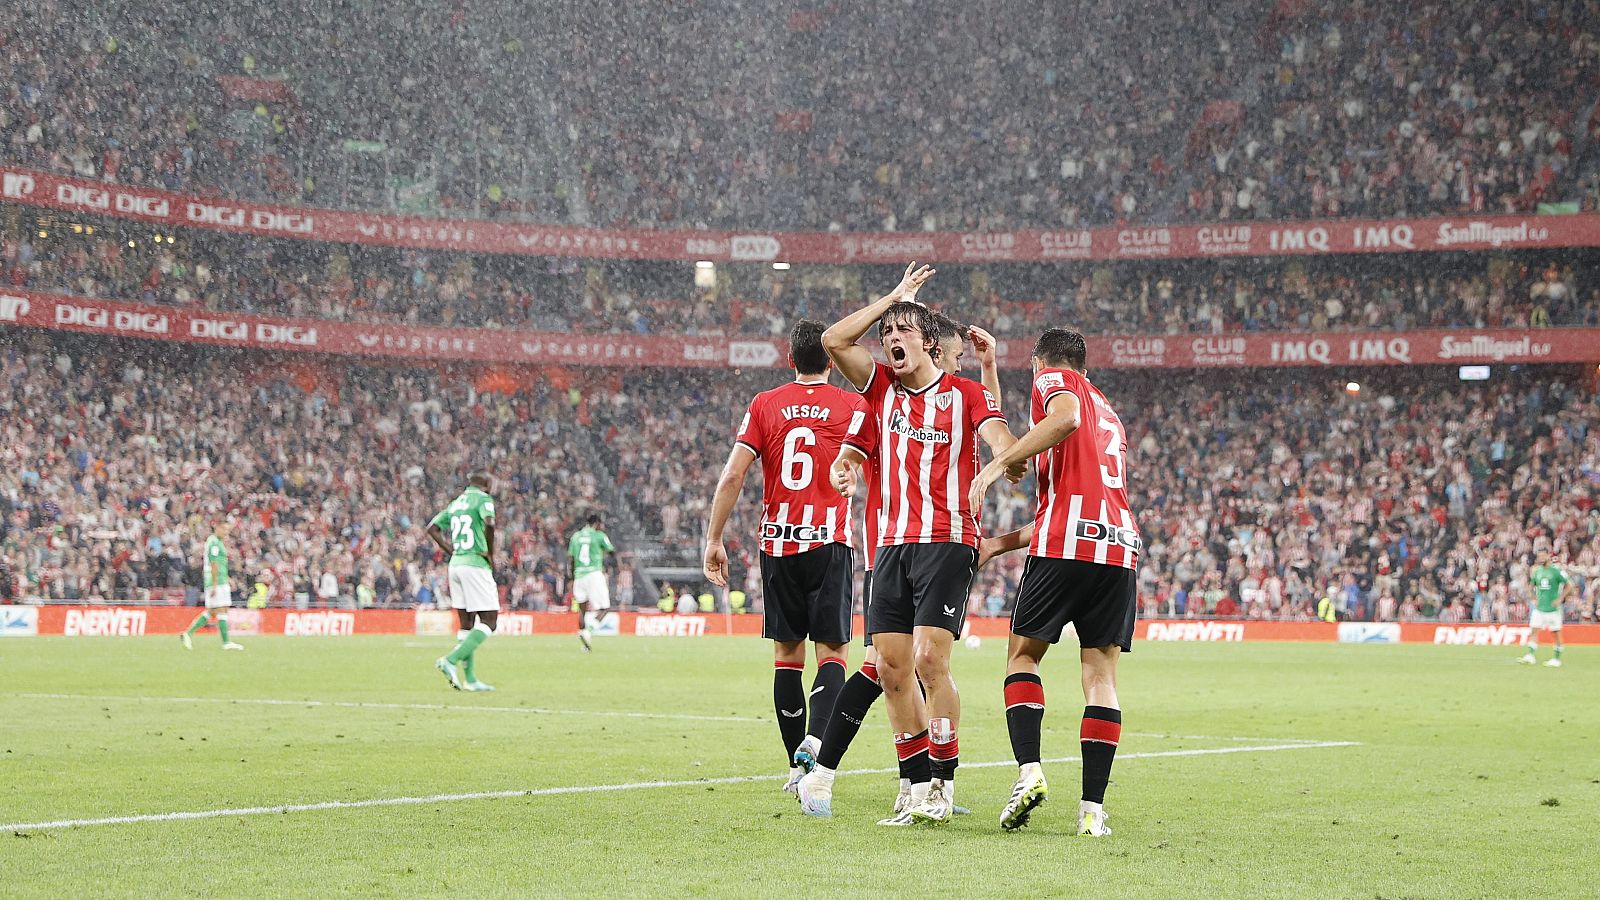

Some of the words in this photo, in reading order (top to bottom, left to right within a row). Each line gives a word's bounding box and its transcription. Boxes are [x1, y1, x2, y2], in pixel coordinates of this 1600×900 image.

[57, 184, 110, 209] DIGI
[115, 193, 170, 217] DIGI
[187, 202, 245, 227] DIGI
[251, 211, 314, 233] DIGI
[961, 233, 1015, 249] CLUB
[1040, 231, 1092, 248] CLUB
[1118, 228, 1171, 245] CLUB
[1197, 225, 1252, 243] CLUB
[1270, 227, 1330, 250] IMQ
[1353, 224, 1416, 249] IMQ
[55, 304, 109, 328] DIGI
[114, 309, 169, 334] DIGI
[190, 319, 248, 340] DIGI
[255, 323, 318, 346] DIGI
[1112, 338, 1166, 355] CLUB
[1191, 337, 1247, 355] CLUB
[1270, 339, 1332, 363] IMQ
[1350, 338, 1412, 363] IMQ
[781, 405, 831, 421] VESGA
[781, 426, 816, 491] 6
[1098, 416, 1124, 489] 3
[450, 514, 475, 550] 23
[762, 523, 830, 541] DIGI
[1076, 520, 1142, 550] DIG
[578, 543, 592, 566] 4
[1434, 624, 1532, 645] ENERYET
